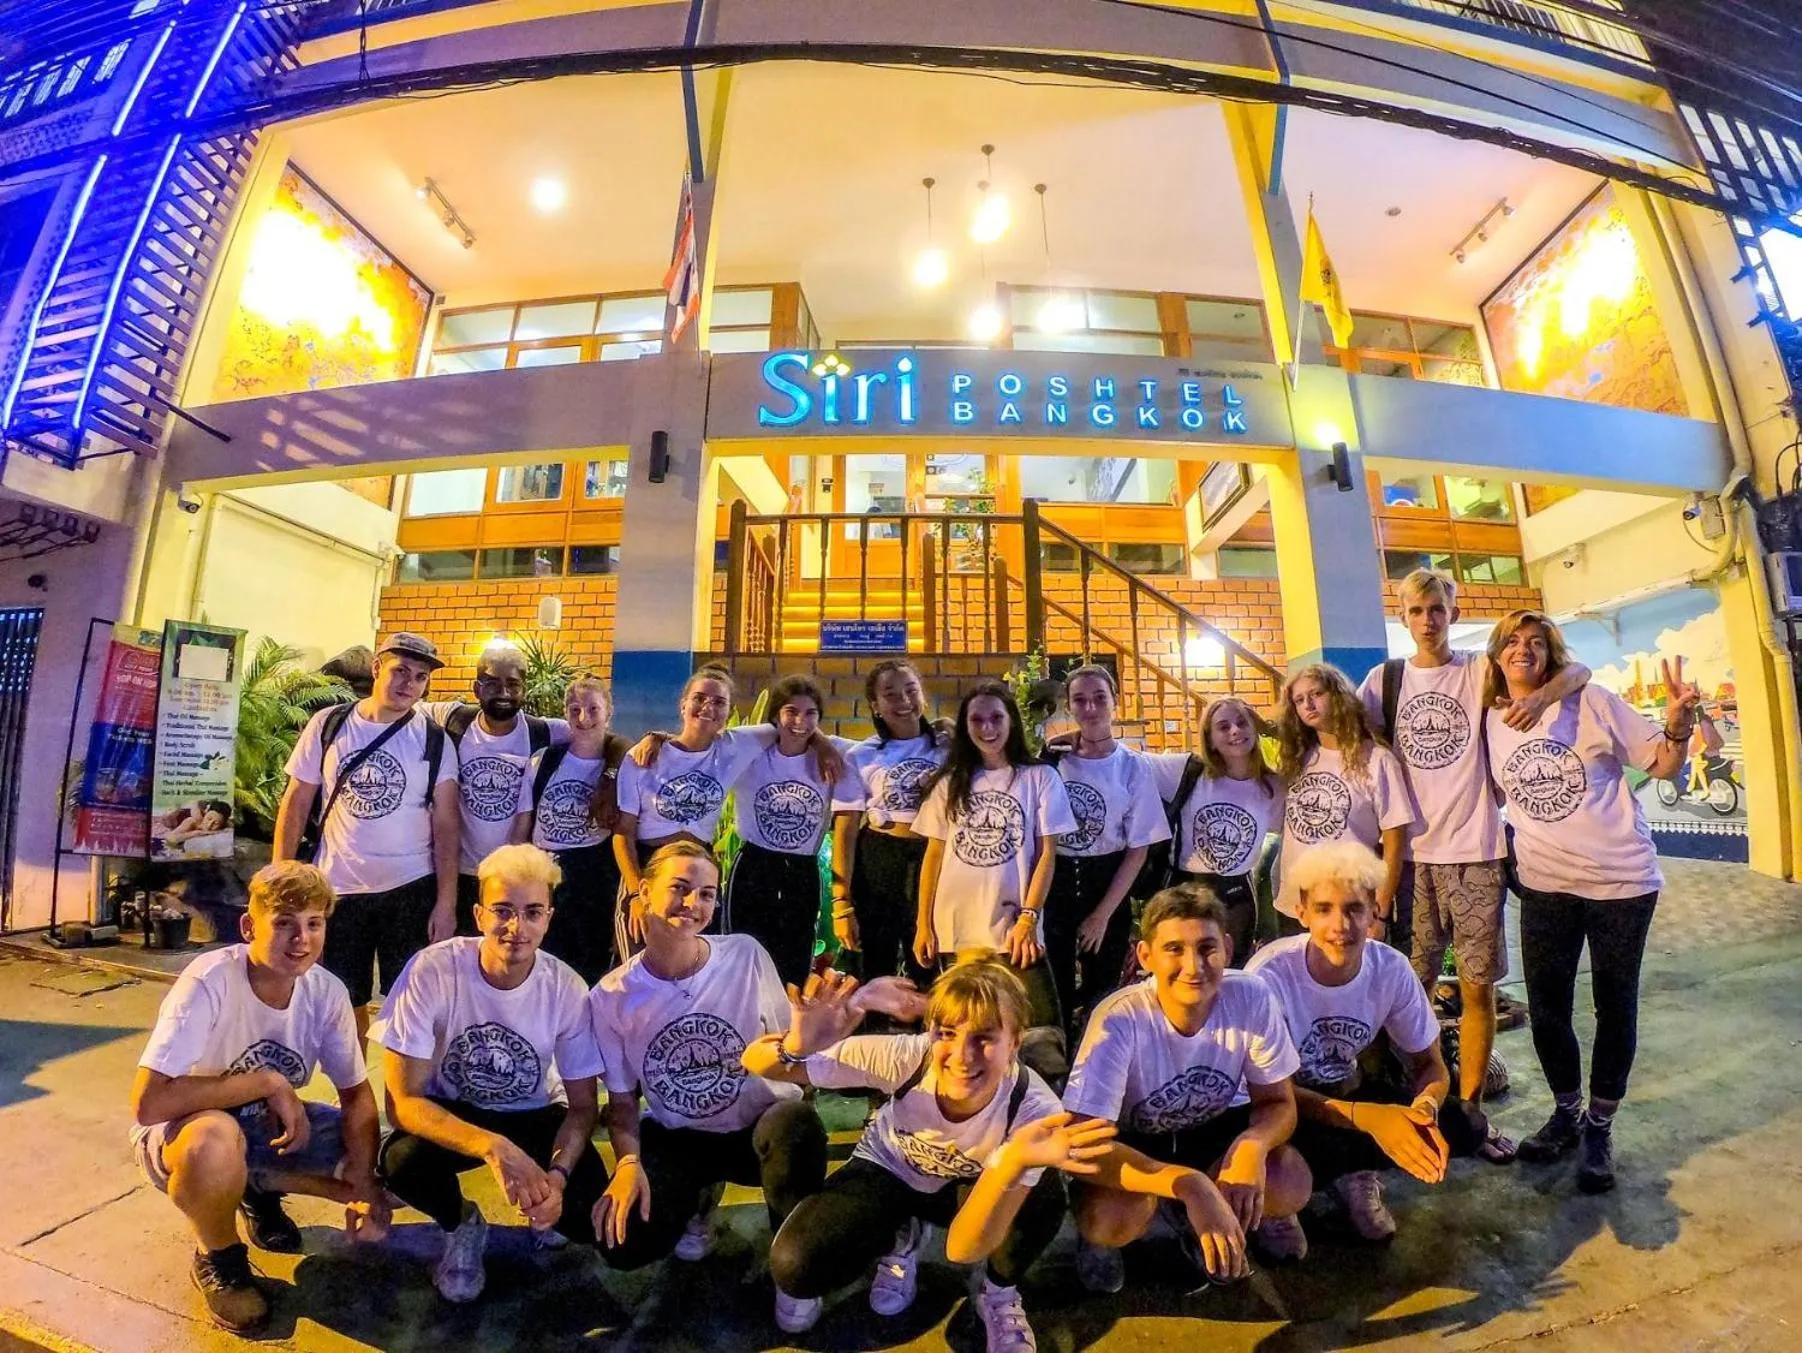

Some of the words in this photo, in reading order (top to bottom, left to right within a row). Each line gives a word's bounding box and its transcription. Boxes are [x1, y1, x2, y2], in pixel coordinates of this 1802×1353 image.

[759, 352, 917, 426] Siri
[952, 374, 1242, 405] POSHTEL
[953, 401, 1247, 431] BANGKOK
[1402, 696, 1463, 720] BANGKOK
[1401, 734, 1465, 762] BANGKOK
[1507, 743, 1573, 773] BANGKOK
[463, 761, 524, 780] BANGKOK
[889, 761, 938, 780] BANGKO
[544, 784, 592, 801] BANGK
[759, 785, 820, 807] BANGKOK
[1064, 784, 1103, 813] NGKOK
[1291, 776, 1347, 802] BANGKOK
[1510, 780, 1580, 815] BANGKOK
[542, 814, 587, 841] BANGKO
[760, 813, 818, 843] BANGKOK
[1198, 807, 1254, 837] BANGKOK
[1287, 806, 1343, 839] BANGKOK
[955, 831, 1020, 860] BANGKOK
[650, 1019, 734, 1061] BANGKOK
[654, 1064, 745, 1110] BANGKOK
